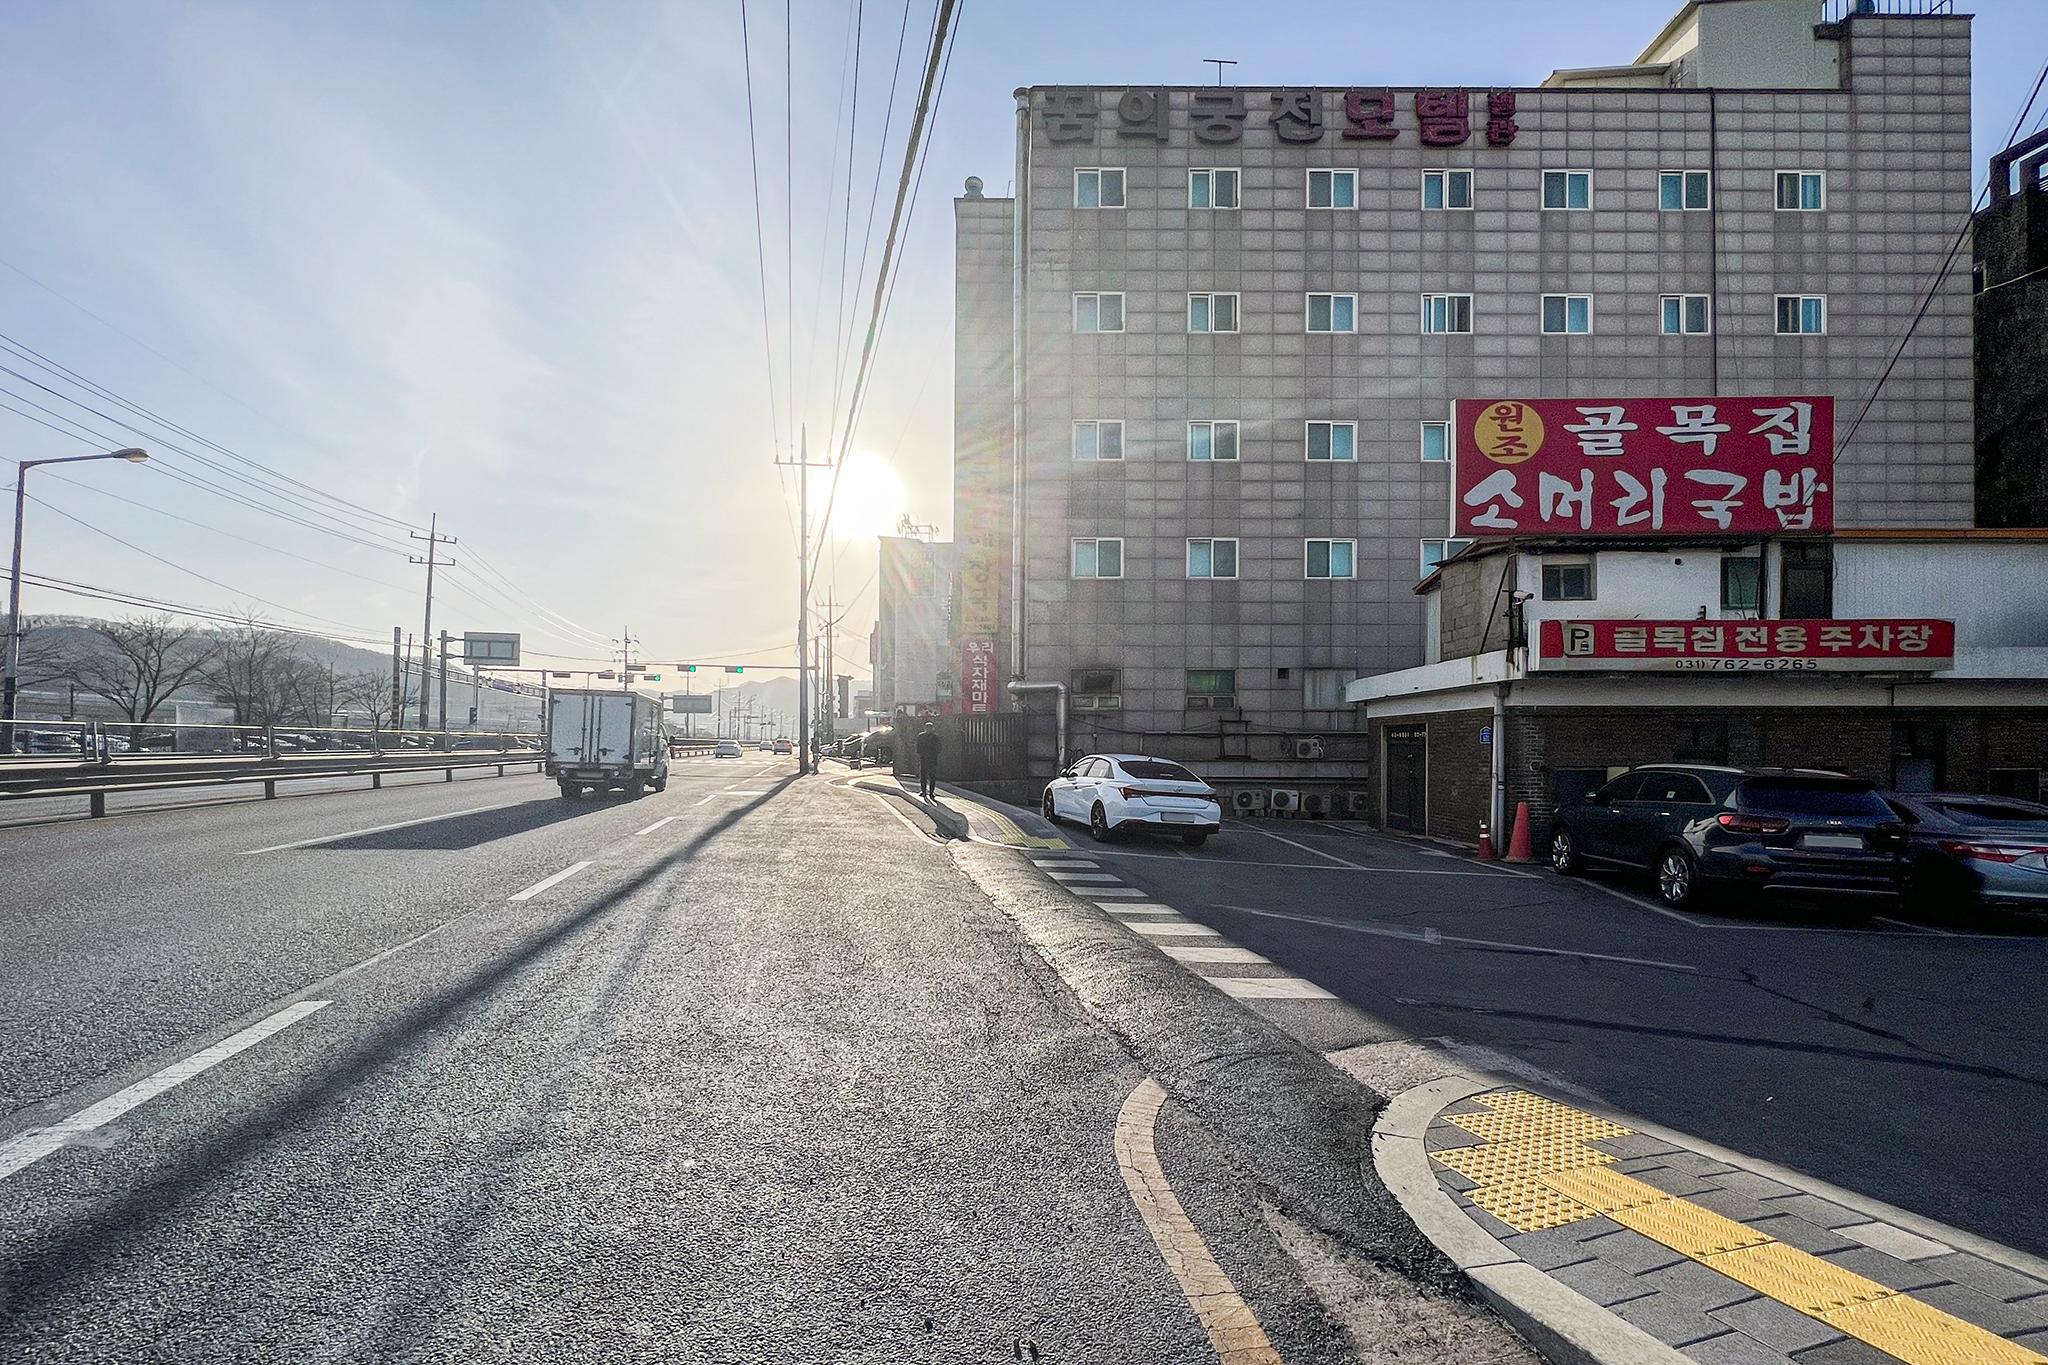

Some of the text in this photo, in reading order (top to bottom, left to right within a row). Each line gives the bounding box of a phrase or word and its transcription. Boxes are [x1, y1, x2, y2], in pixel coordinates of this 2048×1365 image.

[1488, 403, 1530, 459] 원조
[1563, 402, 1813, 456] 골목집
[1463, 467, 1828, 530] 소머리국밥
[966, 641, 994, 653] 우리
[971, 655, 989, 712] 식자재마트
